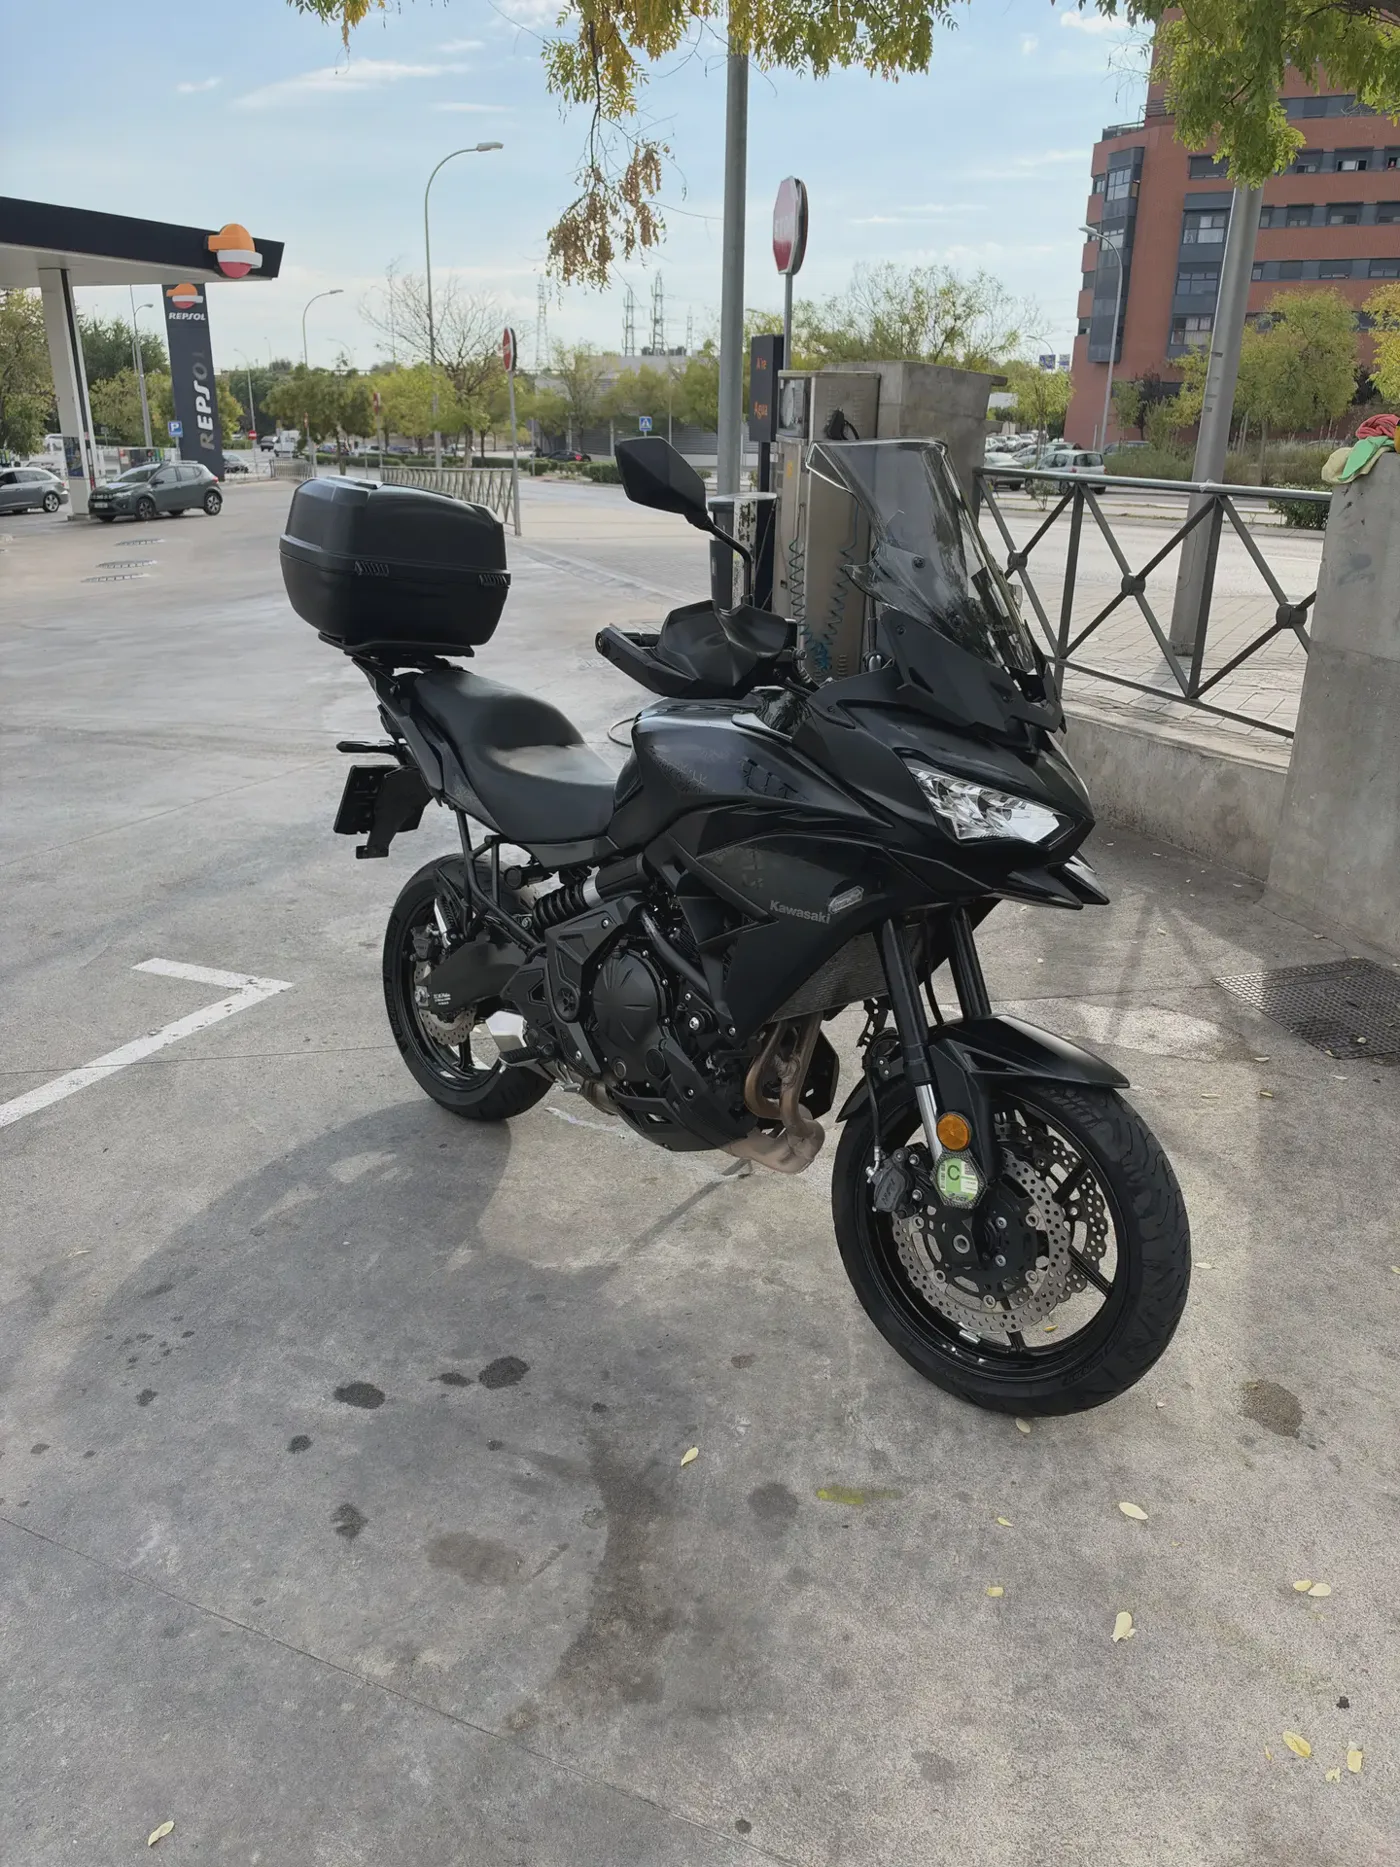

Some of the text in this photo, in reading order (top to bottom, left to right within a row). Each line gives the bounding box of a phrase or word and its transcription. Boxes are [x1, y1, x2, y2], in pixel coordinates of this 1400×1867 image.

[168, 312, 206, 321] REPSOL
[192, 350, 216, 450] REPSOL
[754, 401, 768, 420] Agua
[769, 900, 831, 924] Kawasaki
[947, 1164, 960, 1181] C
